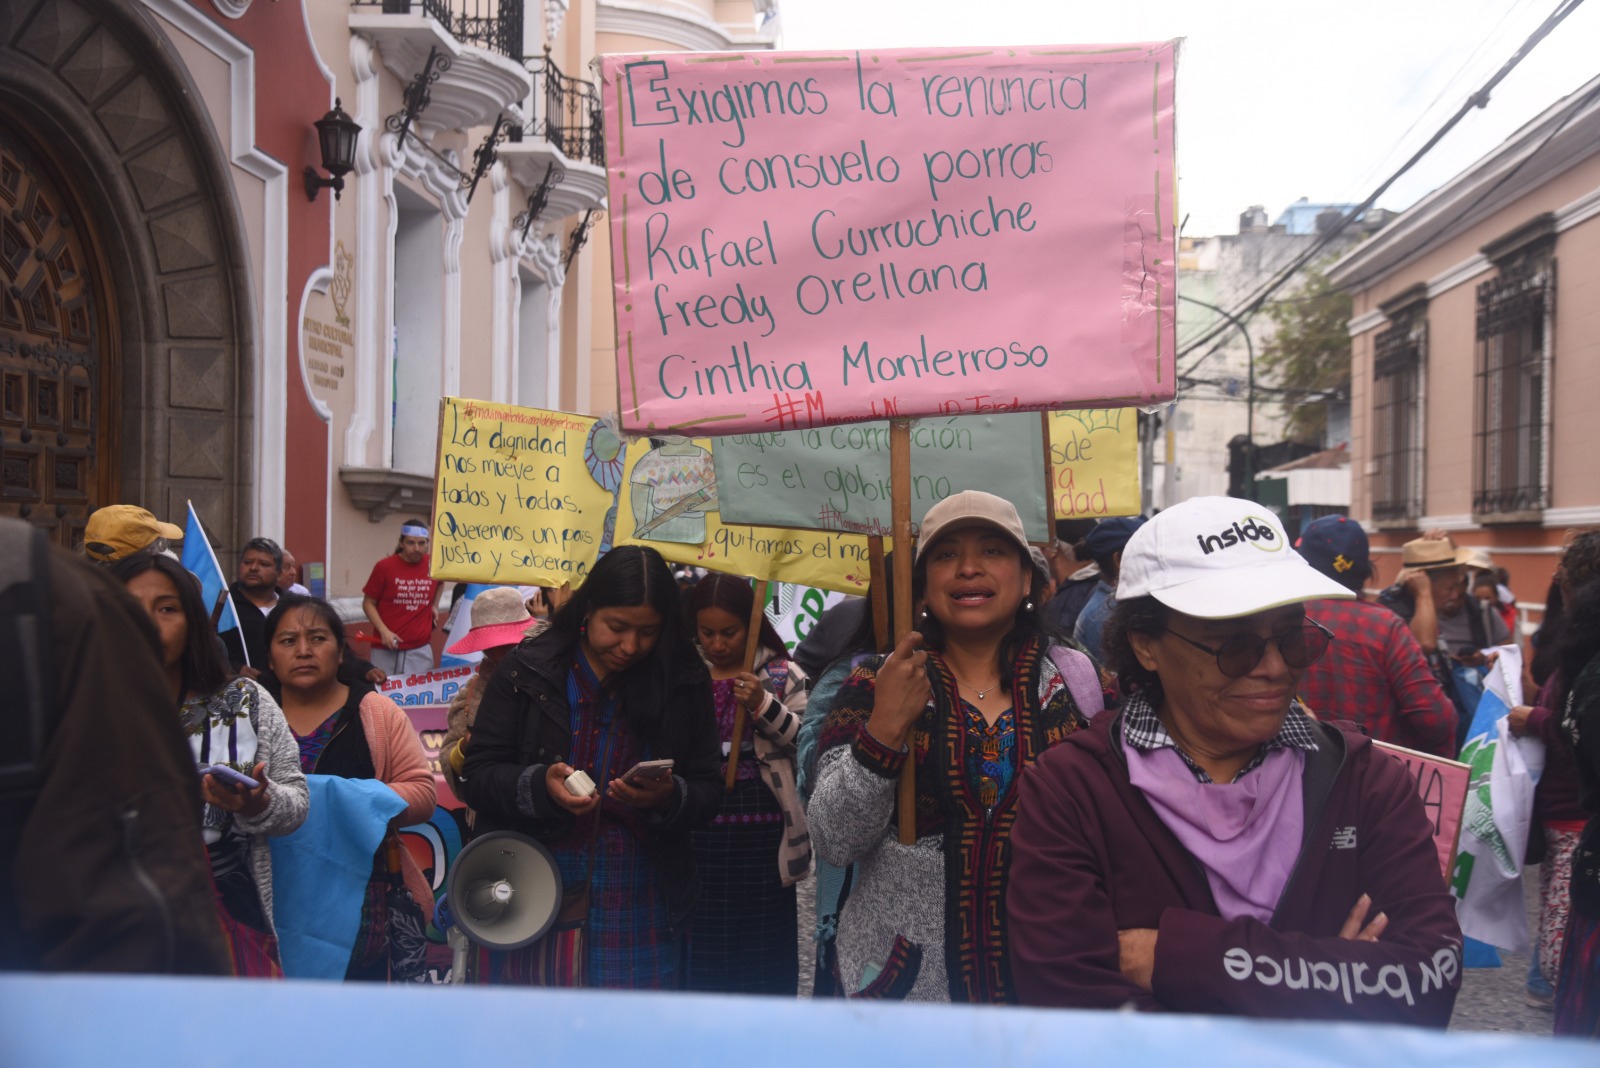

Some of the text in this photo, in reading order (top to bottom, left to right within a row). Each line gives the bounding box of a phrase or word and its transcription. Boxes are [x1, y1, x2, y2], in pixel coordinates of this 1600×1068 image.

[625, 50, 1087, 147] Exigimos la renuncia
[638, 138, 1053, 205] de consuelo porras
[646, 196, 1037, 281] Rafael Curruchiche
[796, 262, 988, 315] Orellana
[659, 334, 1049, 399] Cinthia Monterroso
[451, 403, 567, 460] La dignidad
[801, 428, 822, 450] la
[830, 417, 973, 452] corrción
[445, 453, 560, 483] nos mueve a
[441, 477, 582, 515] todos y todas.
[737, 462, 951, 513] es el gobino
[437, 511, 524, 542] Queremos
[532, 526, 558, 545] un
[1197, 518, 1274, 555] inside
[439, 541, 482, 569] justo
[490, 550, 502, 577] y
[812, 536, 831, 559] el
[409, 592, 423, 600] hijos
[381, 679, 402, 692] En
[406, 666, 472, 687] defensa
[389, 681, 465, 706] San P
[1223, 947, 1415, 1006] balance
